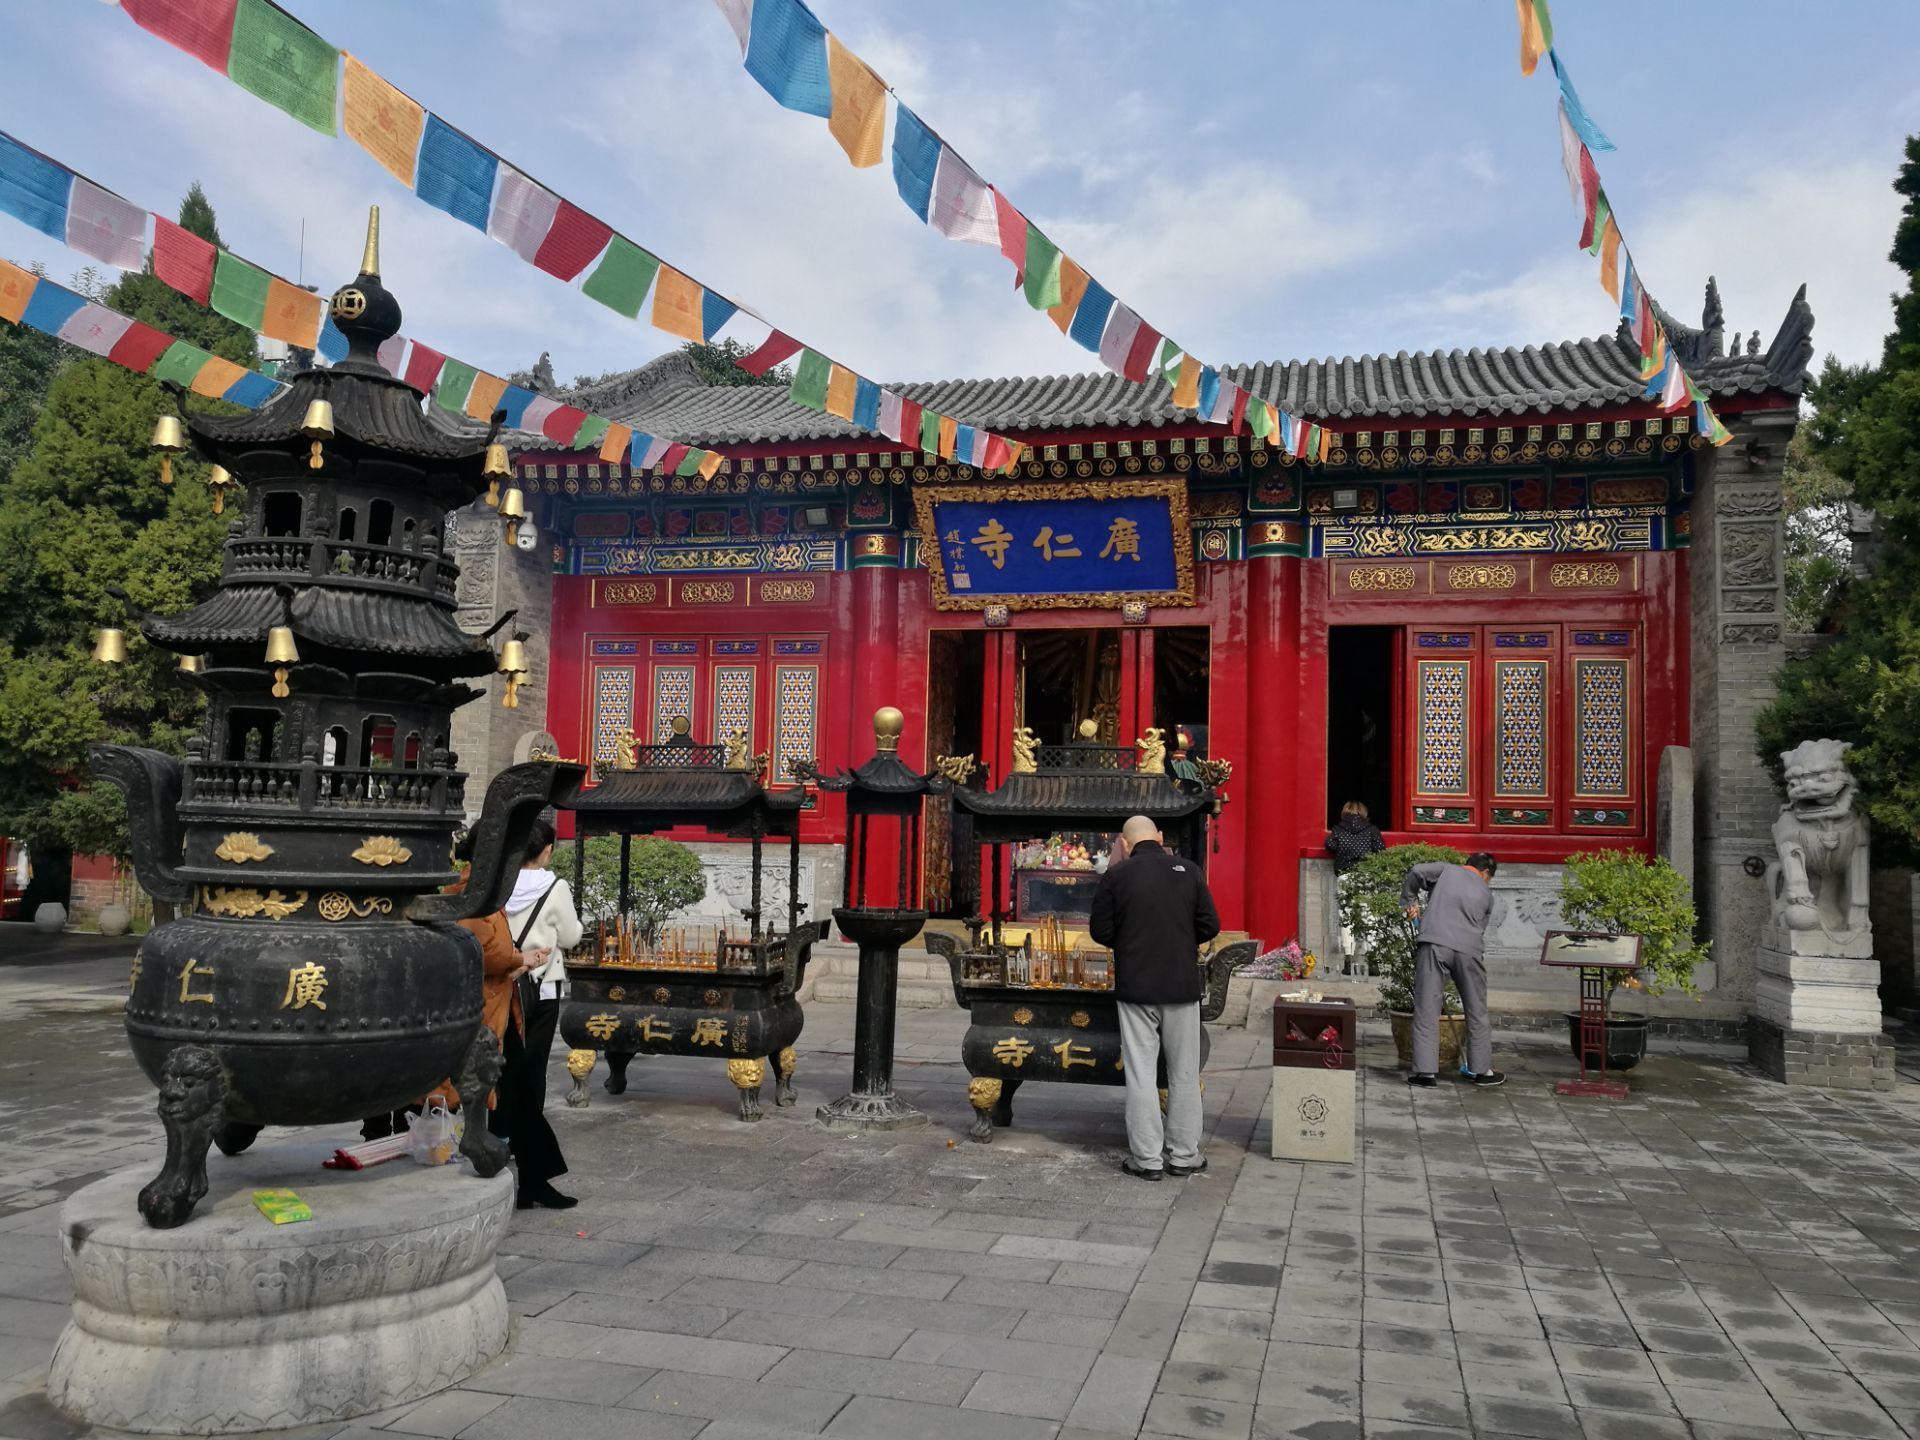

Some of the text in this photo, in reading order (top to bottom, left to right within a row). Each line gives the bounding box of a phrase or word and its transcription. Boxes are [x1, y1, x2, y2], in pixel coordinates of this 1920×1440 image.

[971, 517, 1141, 570] 廣仁寺
[992, 1036, 1124, 1070] 仁寺
